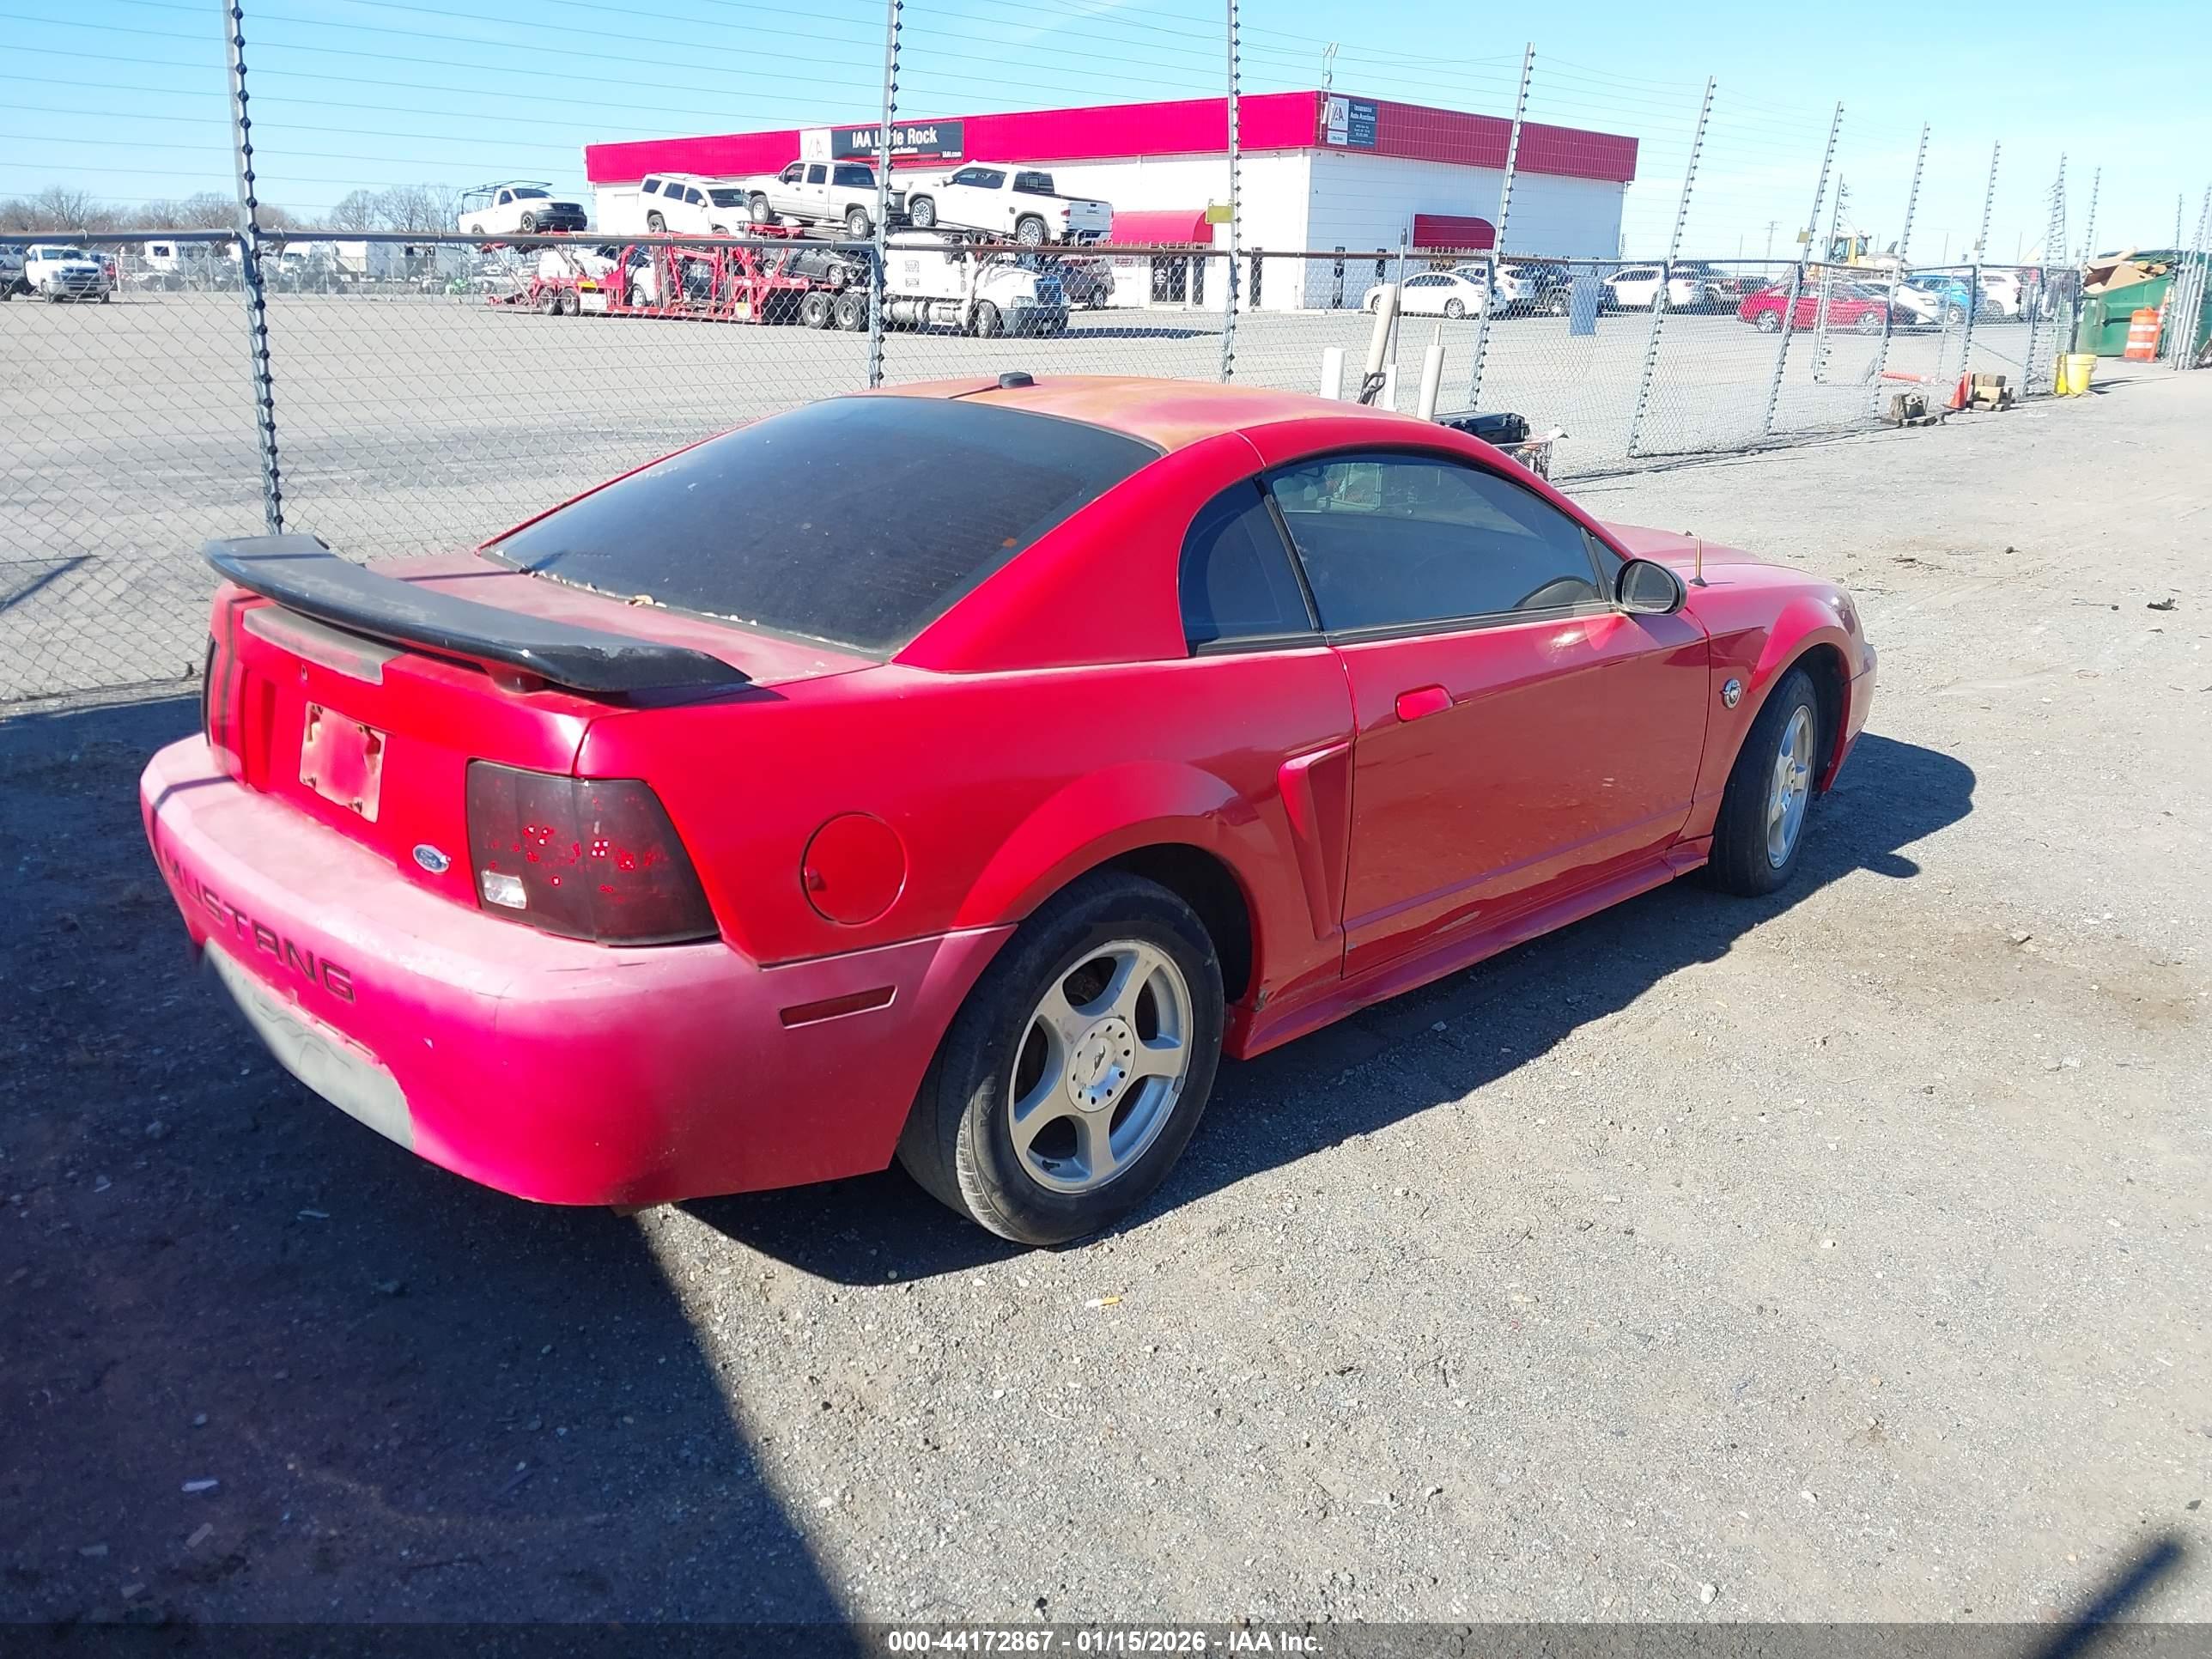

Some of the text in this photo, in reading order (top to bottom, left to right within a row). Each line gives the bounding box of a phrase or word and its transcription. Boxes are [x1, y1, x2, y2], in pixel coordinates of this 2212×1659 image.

[852, 131, 872, 149] IAA
[907, 126, 938, 145] Rock
[161, 848, 356, 1003] MUSTANG
